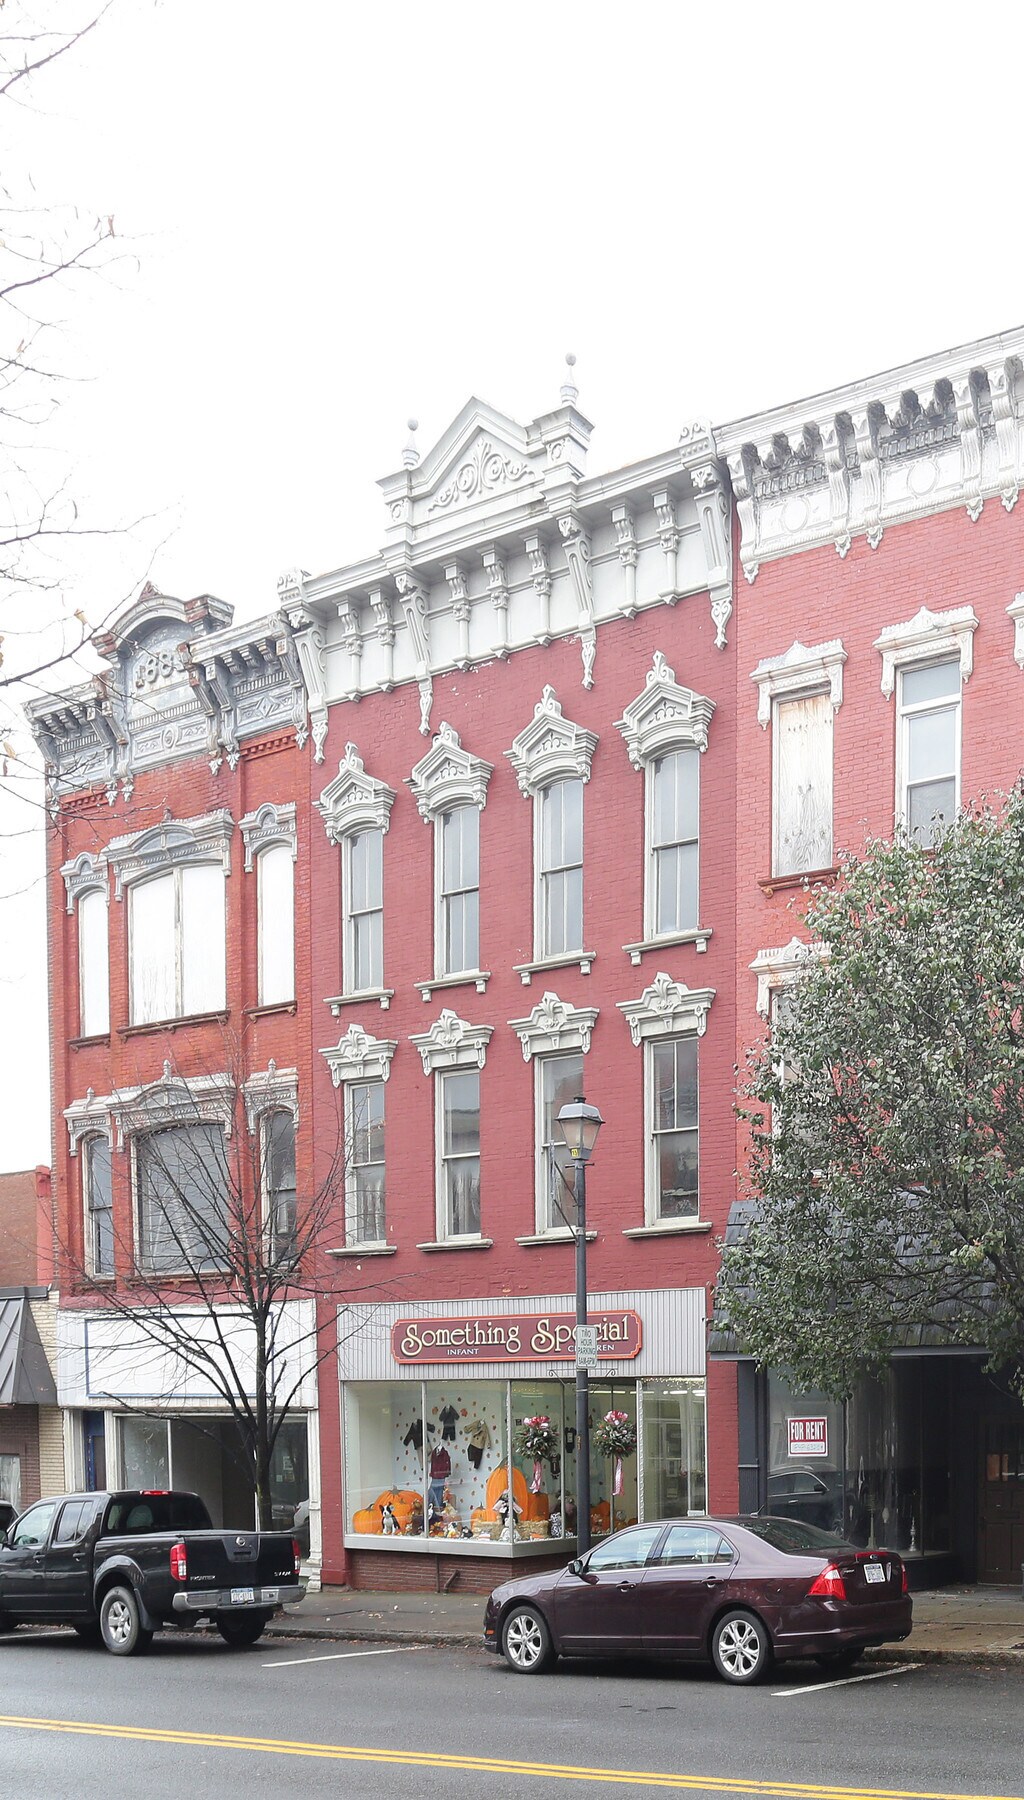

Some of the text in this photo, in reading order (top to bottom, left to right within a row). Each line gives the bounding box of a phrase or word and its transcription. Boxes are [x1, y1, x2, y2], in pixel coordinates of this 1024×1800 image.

[401, 1320, 521, 1357] Something
[447, 1348, 479, 1356] INFANT
[790, 1421, 824, 1440] FOR RENT
